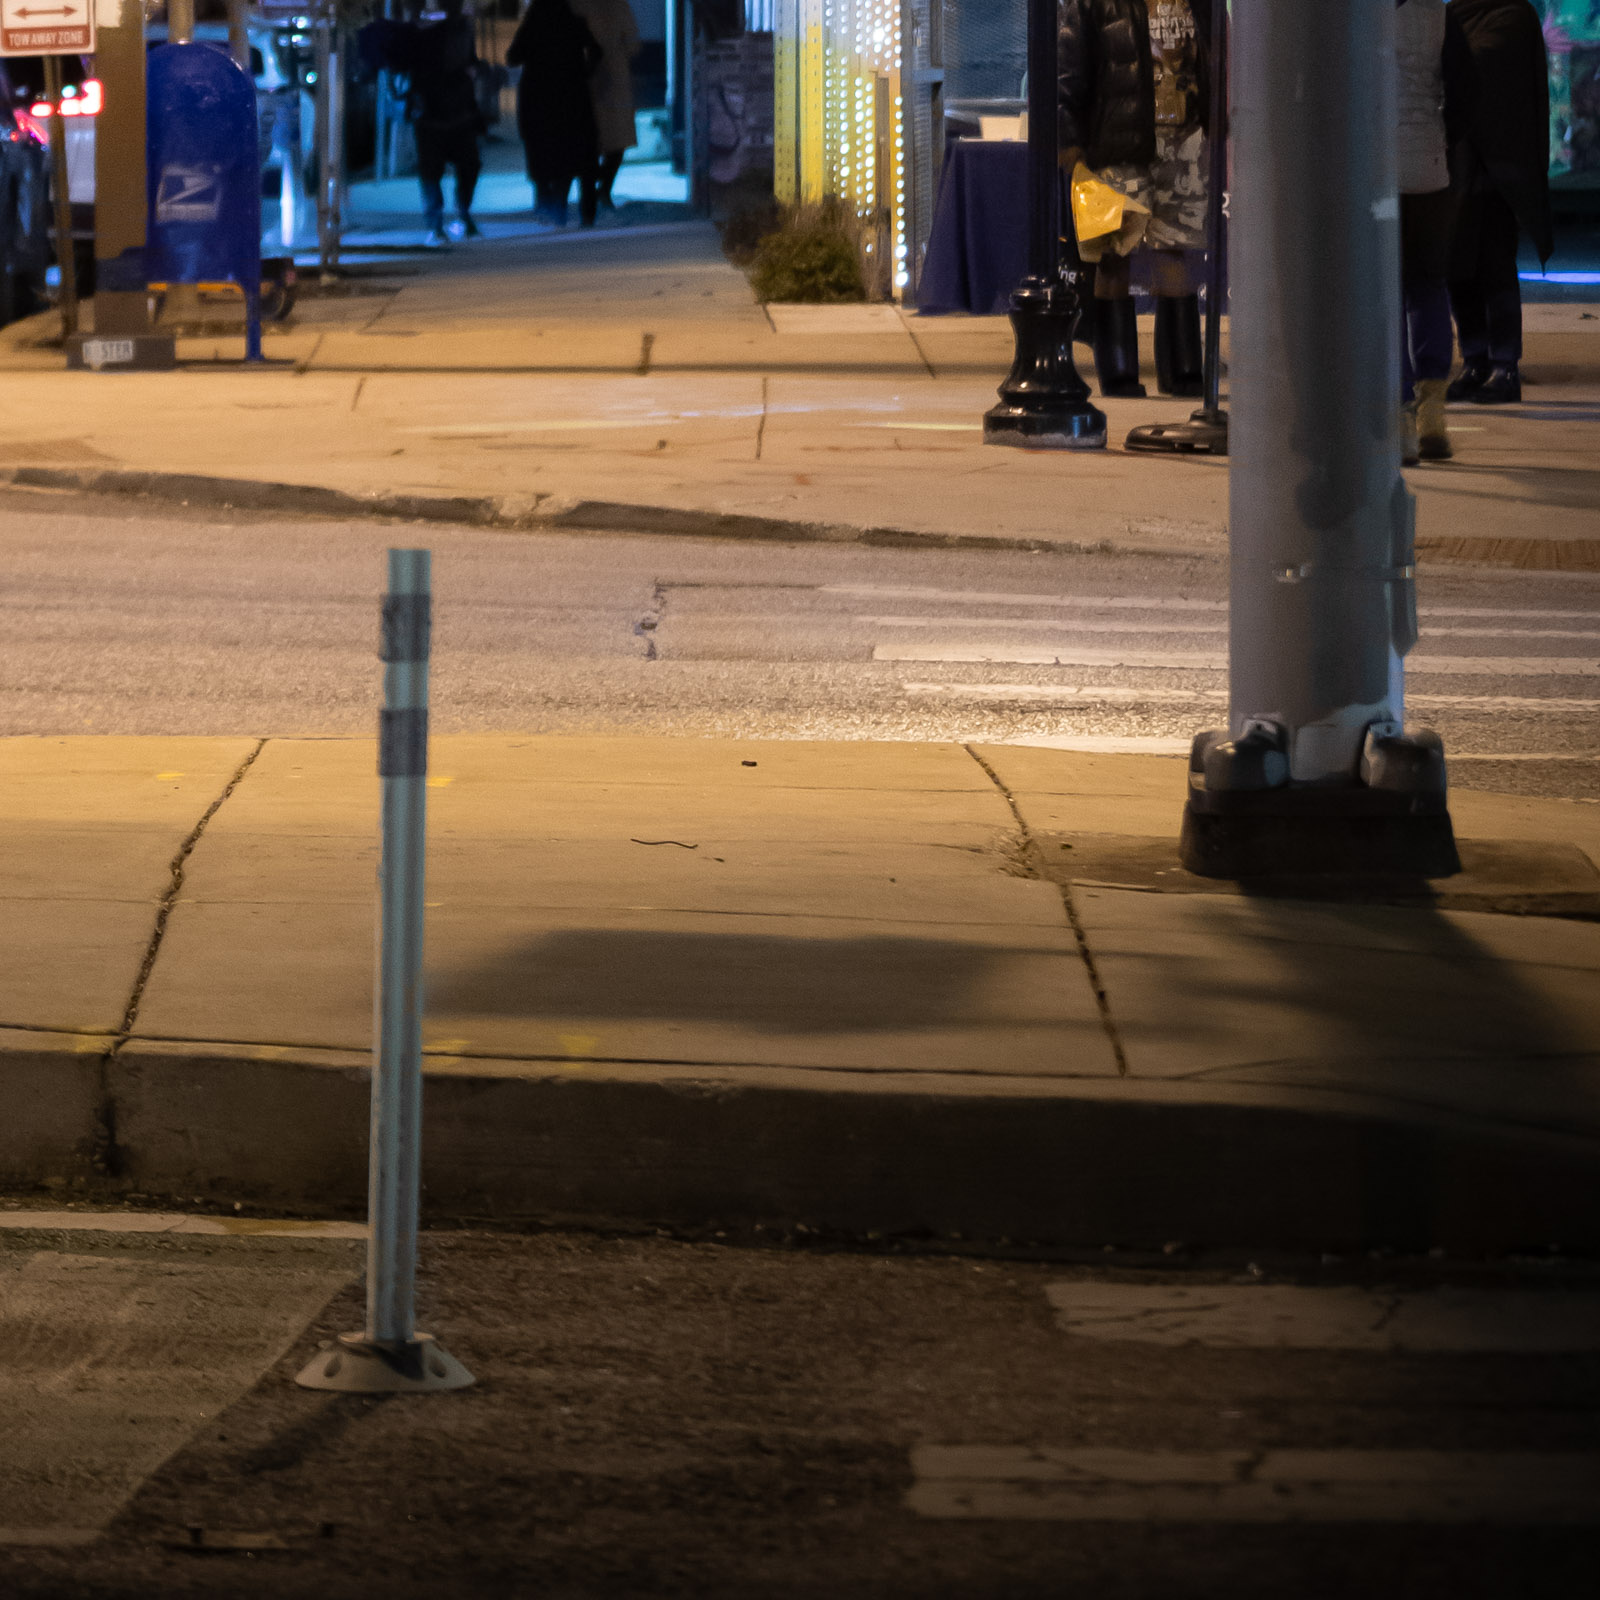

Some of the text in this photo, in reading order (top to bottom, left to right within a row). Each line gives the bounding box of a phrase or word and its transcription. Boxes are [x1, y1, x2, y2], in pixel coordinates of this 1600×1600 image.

[9, 30, 84, 47] TOW AWAY ZONE
